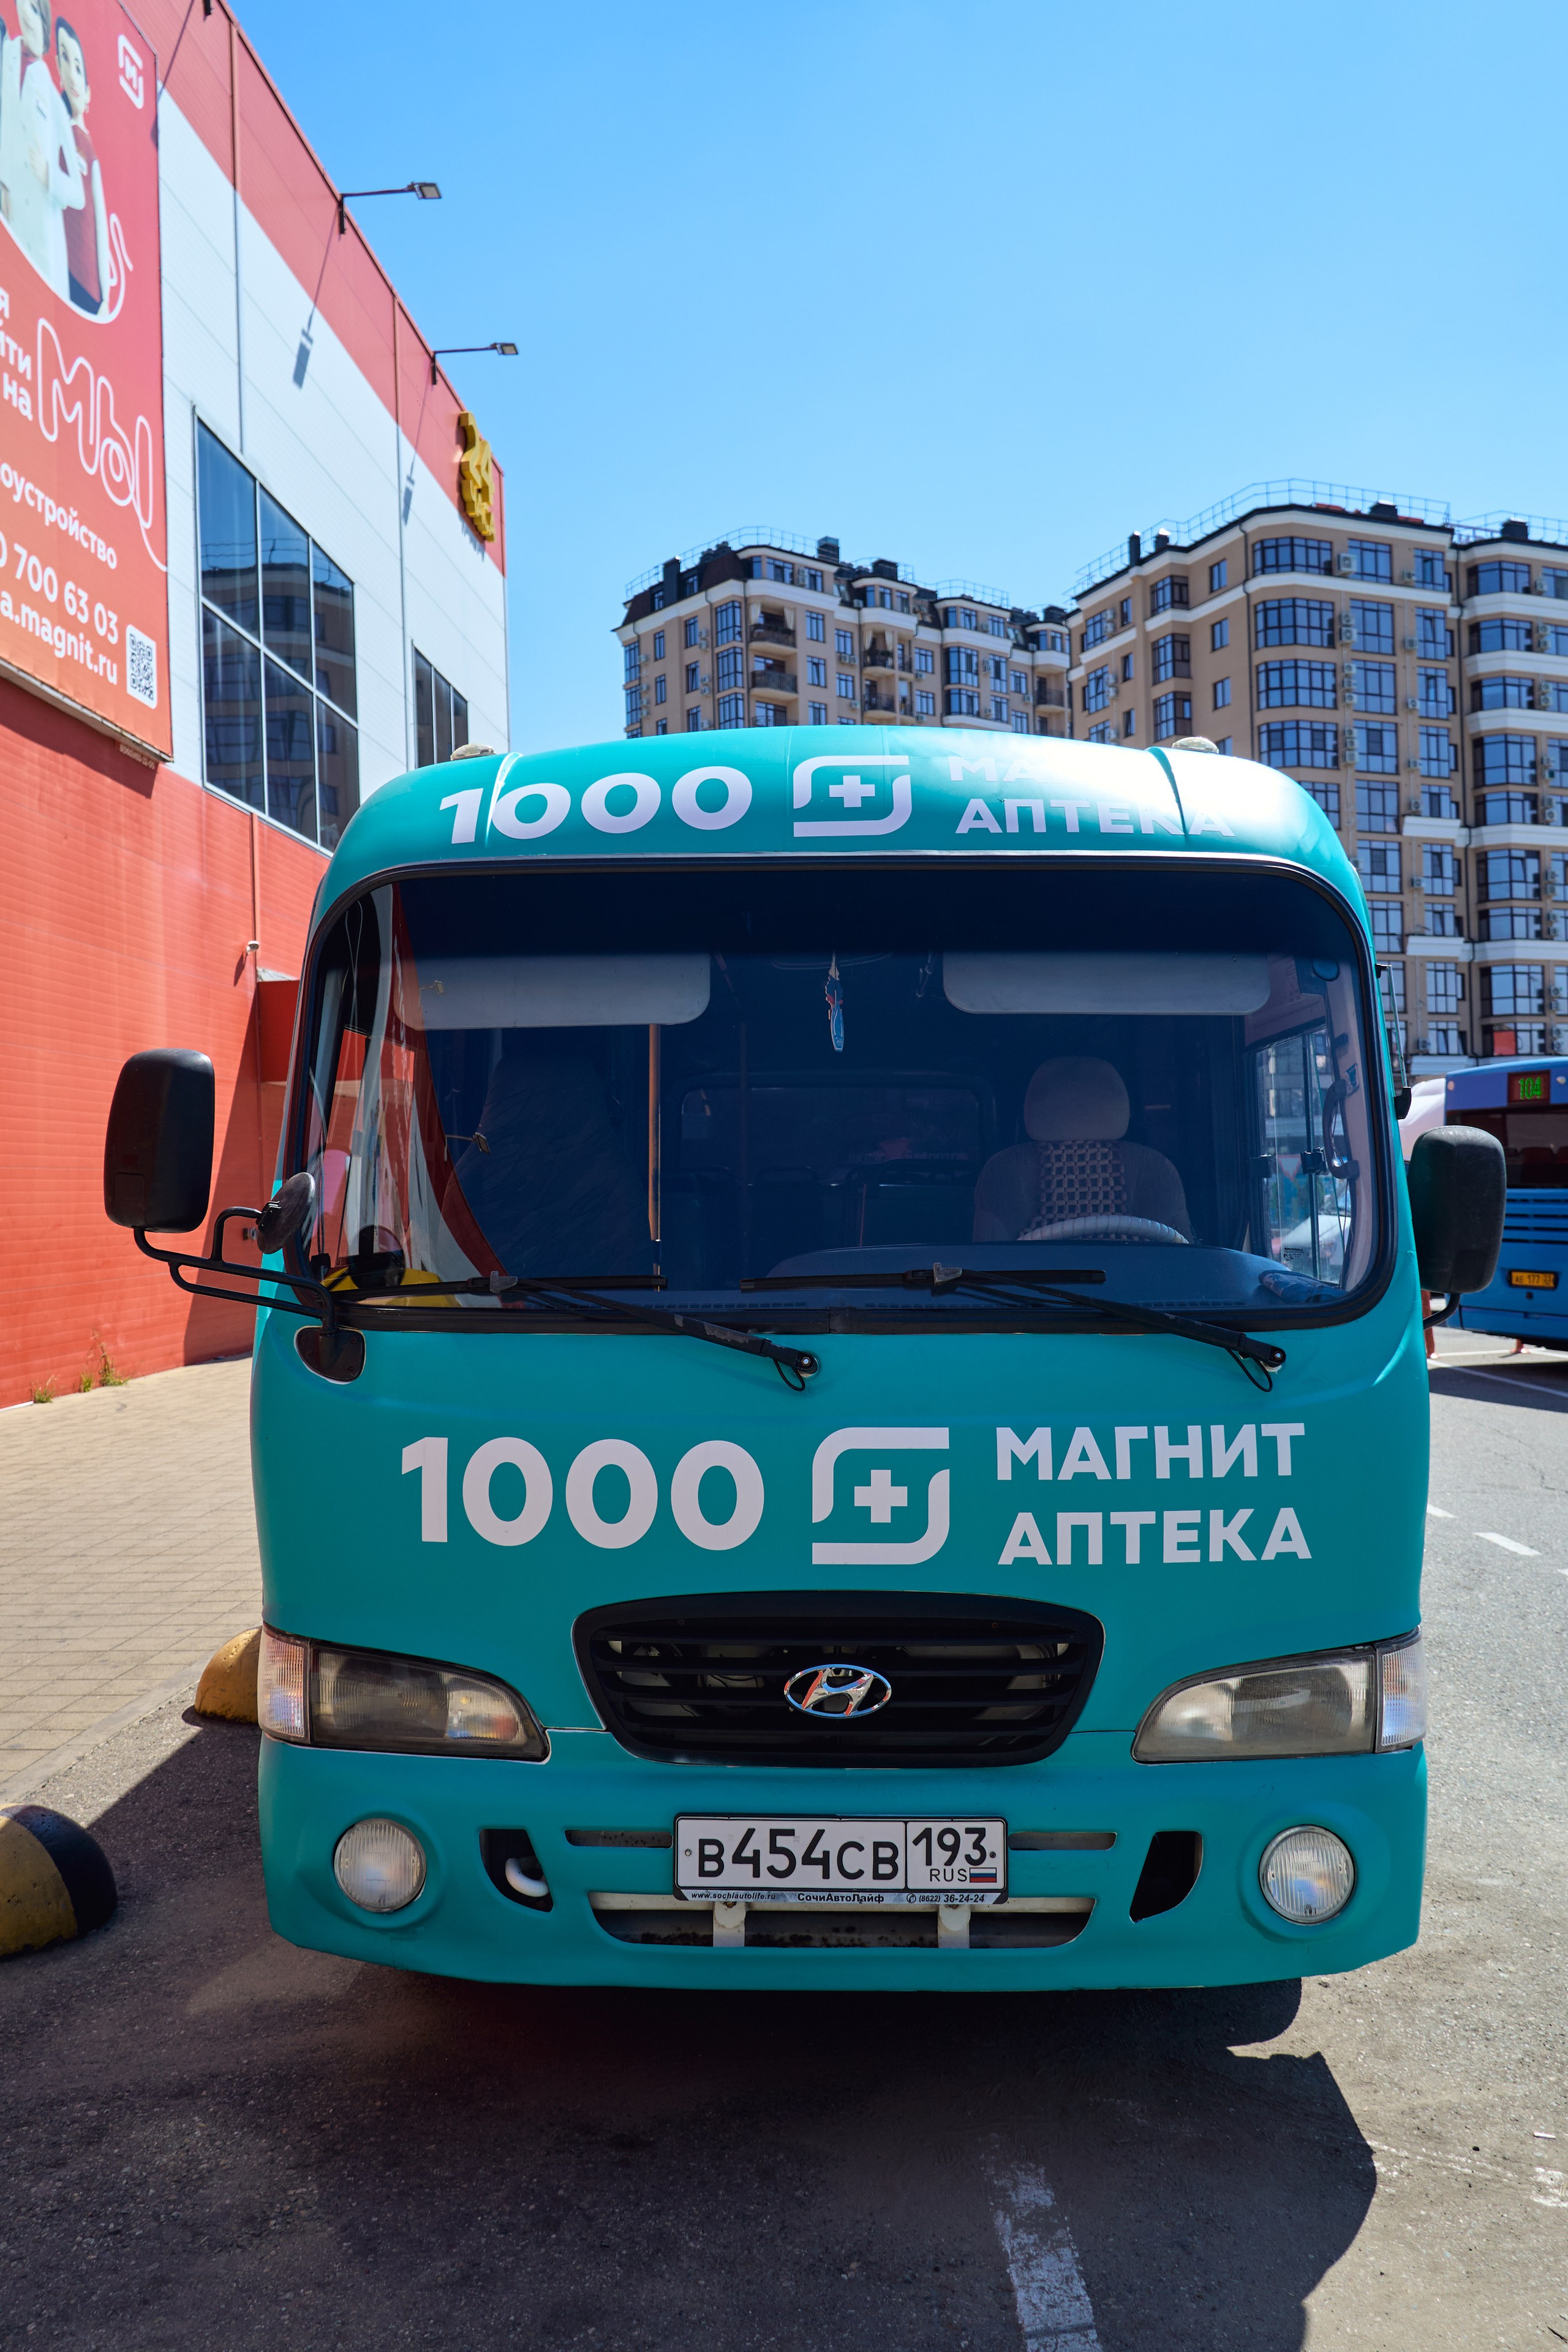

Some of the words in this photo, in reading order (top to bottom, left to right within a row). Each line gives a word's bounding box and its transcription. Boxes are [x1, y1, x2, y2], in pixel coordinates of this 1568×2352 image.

[3, 372, 33, 421] на
[13, 543, 58, 603] 700
[64, 581, 89, 624] 63
[94, 602, 118, 644] 03
[439, 766, 753, 845] 1000
[956, 798, 1235, 837] АПТЕКА
[1519, 1076, 1542, 1100] 104
[996, 1422, 1305, 1480] МАГНИТ
[402, 1437, 764, 1551] 1000
[998, 1507, 1312, 1564] АПТЕКА
[912, 1827, 987, 1867] 193
[929, 1868, 967, 1882] RUS
[944, 1893, 985, 1903] 36-24-24
